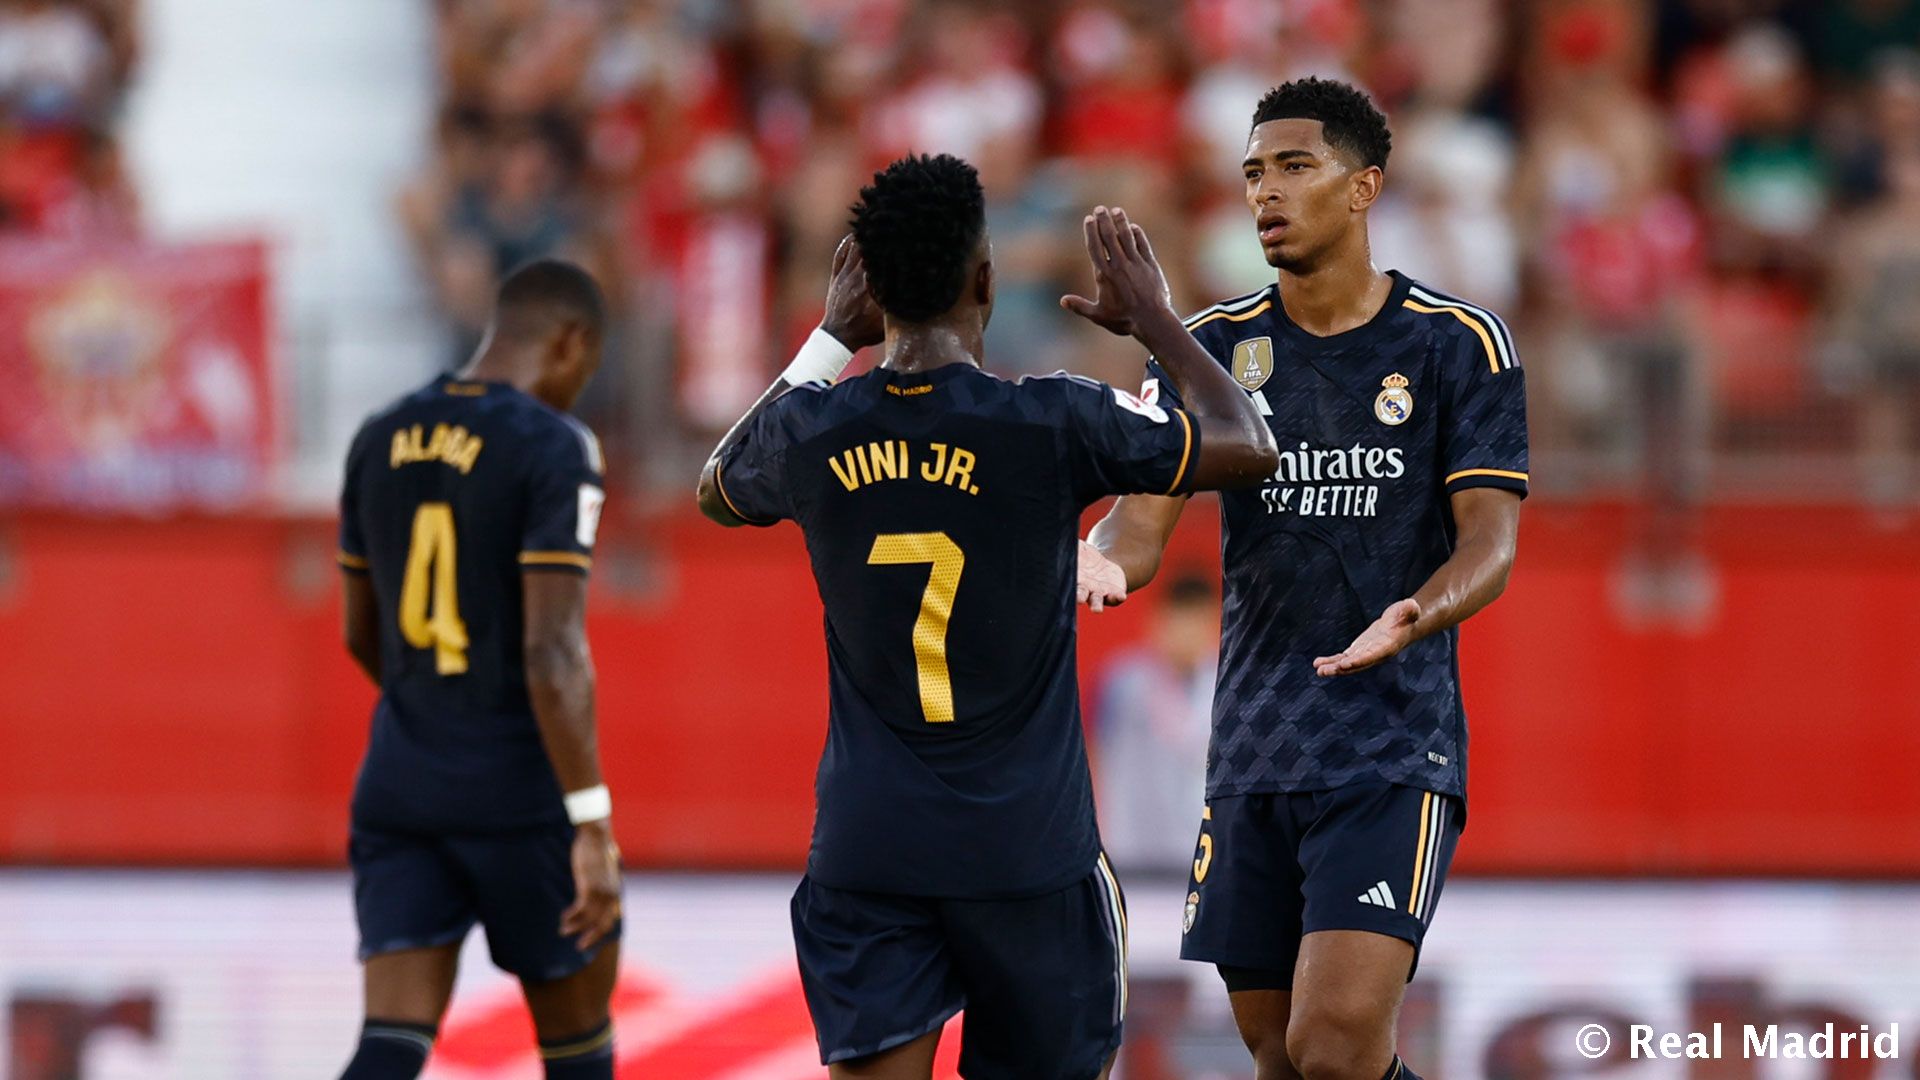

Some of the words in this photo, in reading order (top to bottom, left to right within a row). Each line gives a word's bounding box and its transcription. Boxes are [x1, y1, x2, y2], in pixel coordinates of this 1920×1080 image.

[1243, 370, 1261, 378] FIFA
[828, 440, 909, 492] VINI
[921, 443, 981, 496] JR.
[1263, 442, 1405, 483] mirates
[1299, 486, 1379, 517] BETTER
[399, 502, 469, 675] 4
[867, 532, 965, 723] 7
